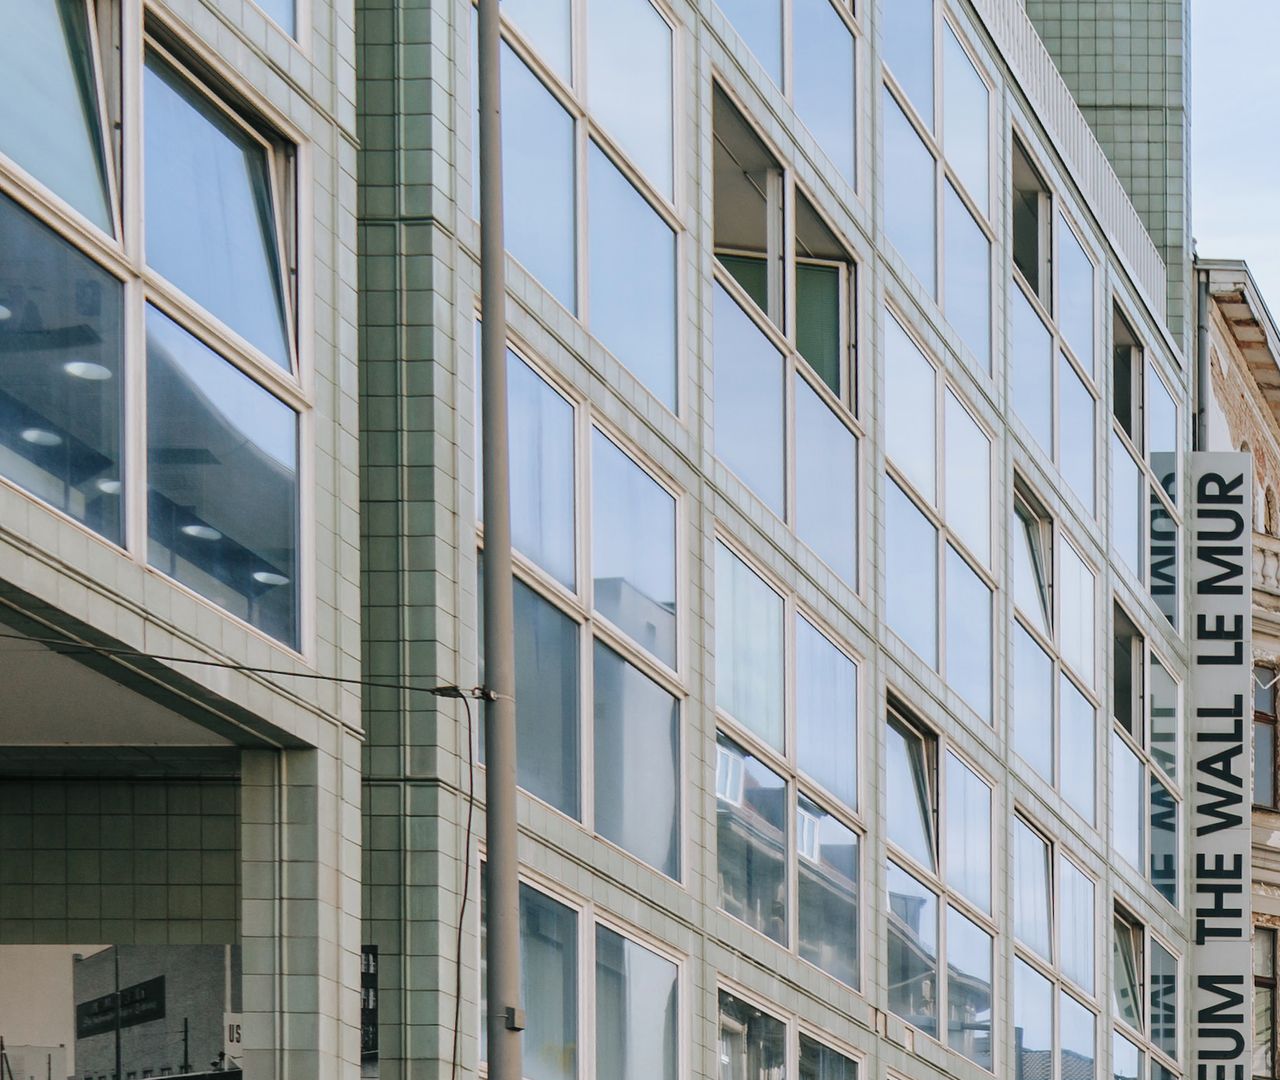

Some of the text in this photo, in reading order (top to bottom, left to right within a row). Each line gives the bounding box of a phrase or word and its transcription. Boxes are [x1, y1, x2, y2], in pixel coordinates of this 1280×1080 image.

[1197, 472, 1244, 596] MUR
[1197, 614, 1244, 665] LE
[1197, 694, 1244, 837] WALL
[1197, 853, 1244, 946] THE
